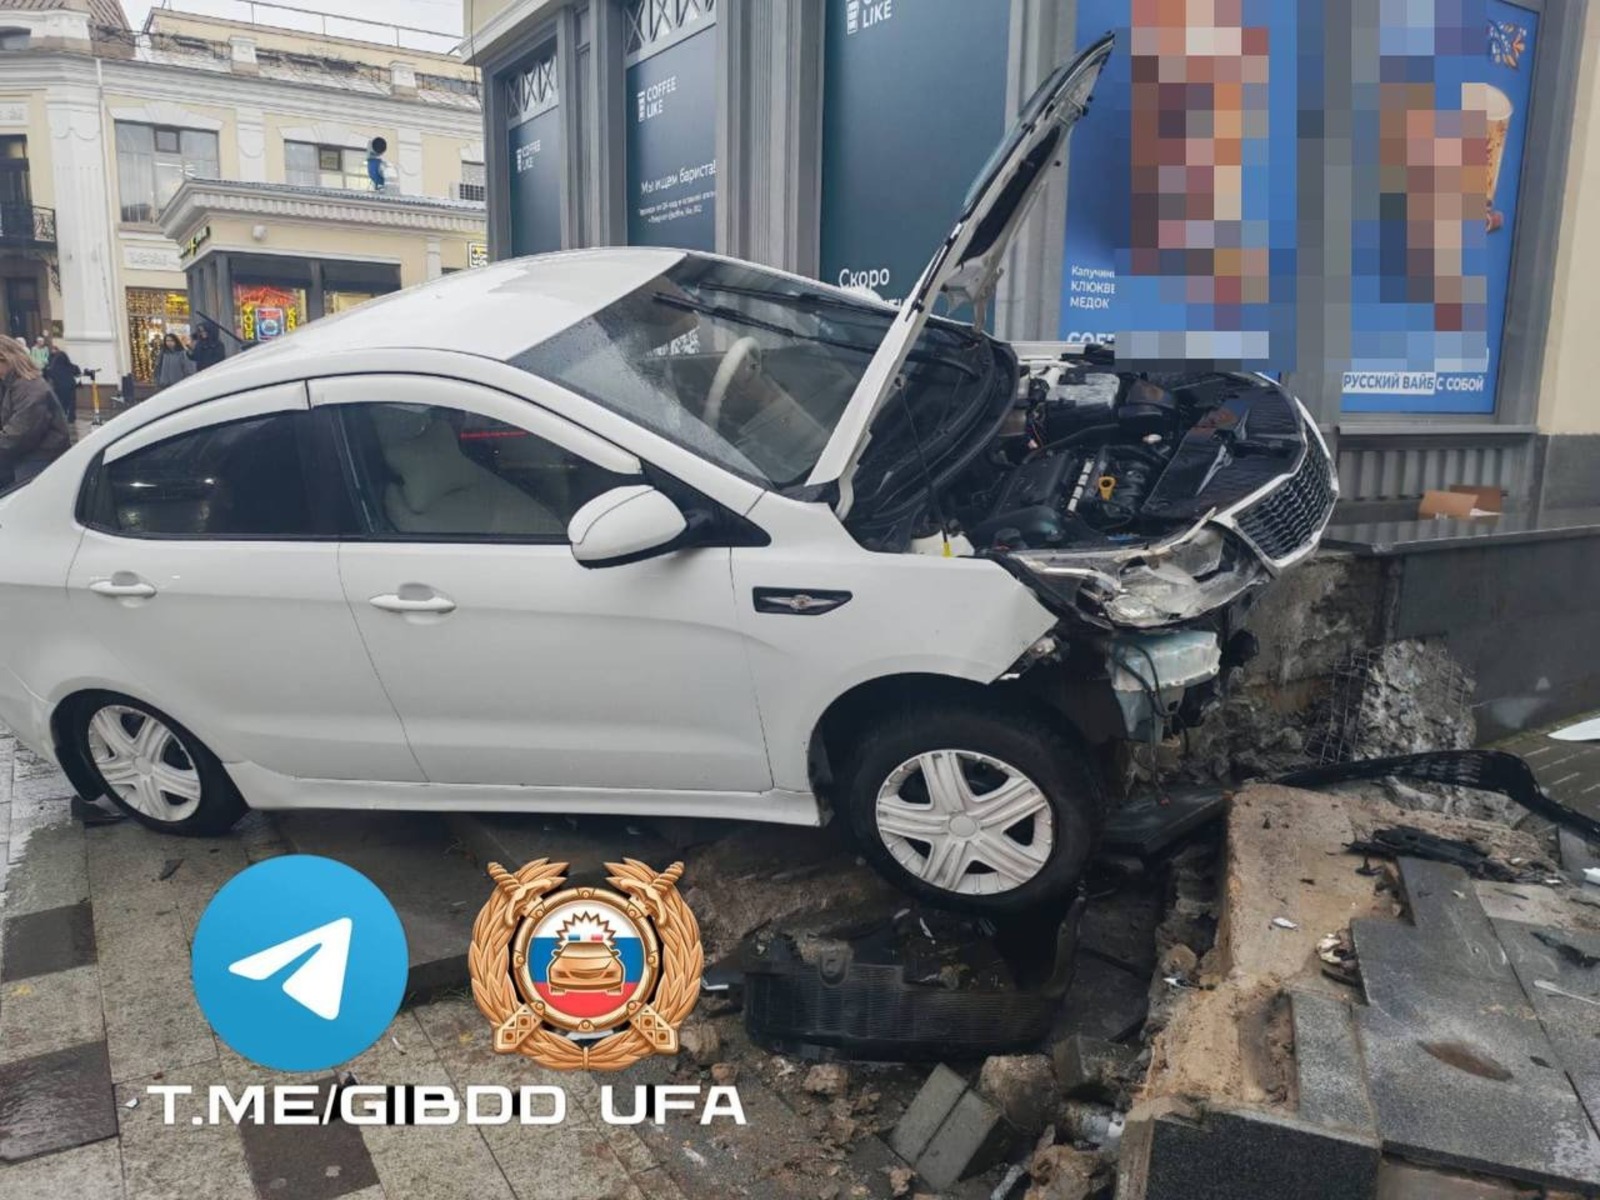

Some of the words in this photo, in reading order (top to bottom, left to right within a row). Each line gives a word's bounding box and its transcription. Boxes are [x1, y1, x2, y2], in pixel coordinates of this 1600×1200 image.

[863, 0, 892, 28] LIKE
[646, 76, 676, 101] COFFEE
[646, 99, 663, 119] LIKE
[838, 267, 890, 290] Скоро
[1069, 296, 1110, 310] МЕДОК
[1342, 372, 1400, 389] РУССКИЙ
[1402, 373, 1435, 390] ВАЙБ
[1436, 377, 1444, 390] С
[1446, 375, 1484, 392] СОБОЙ
